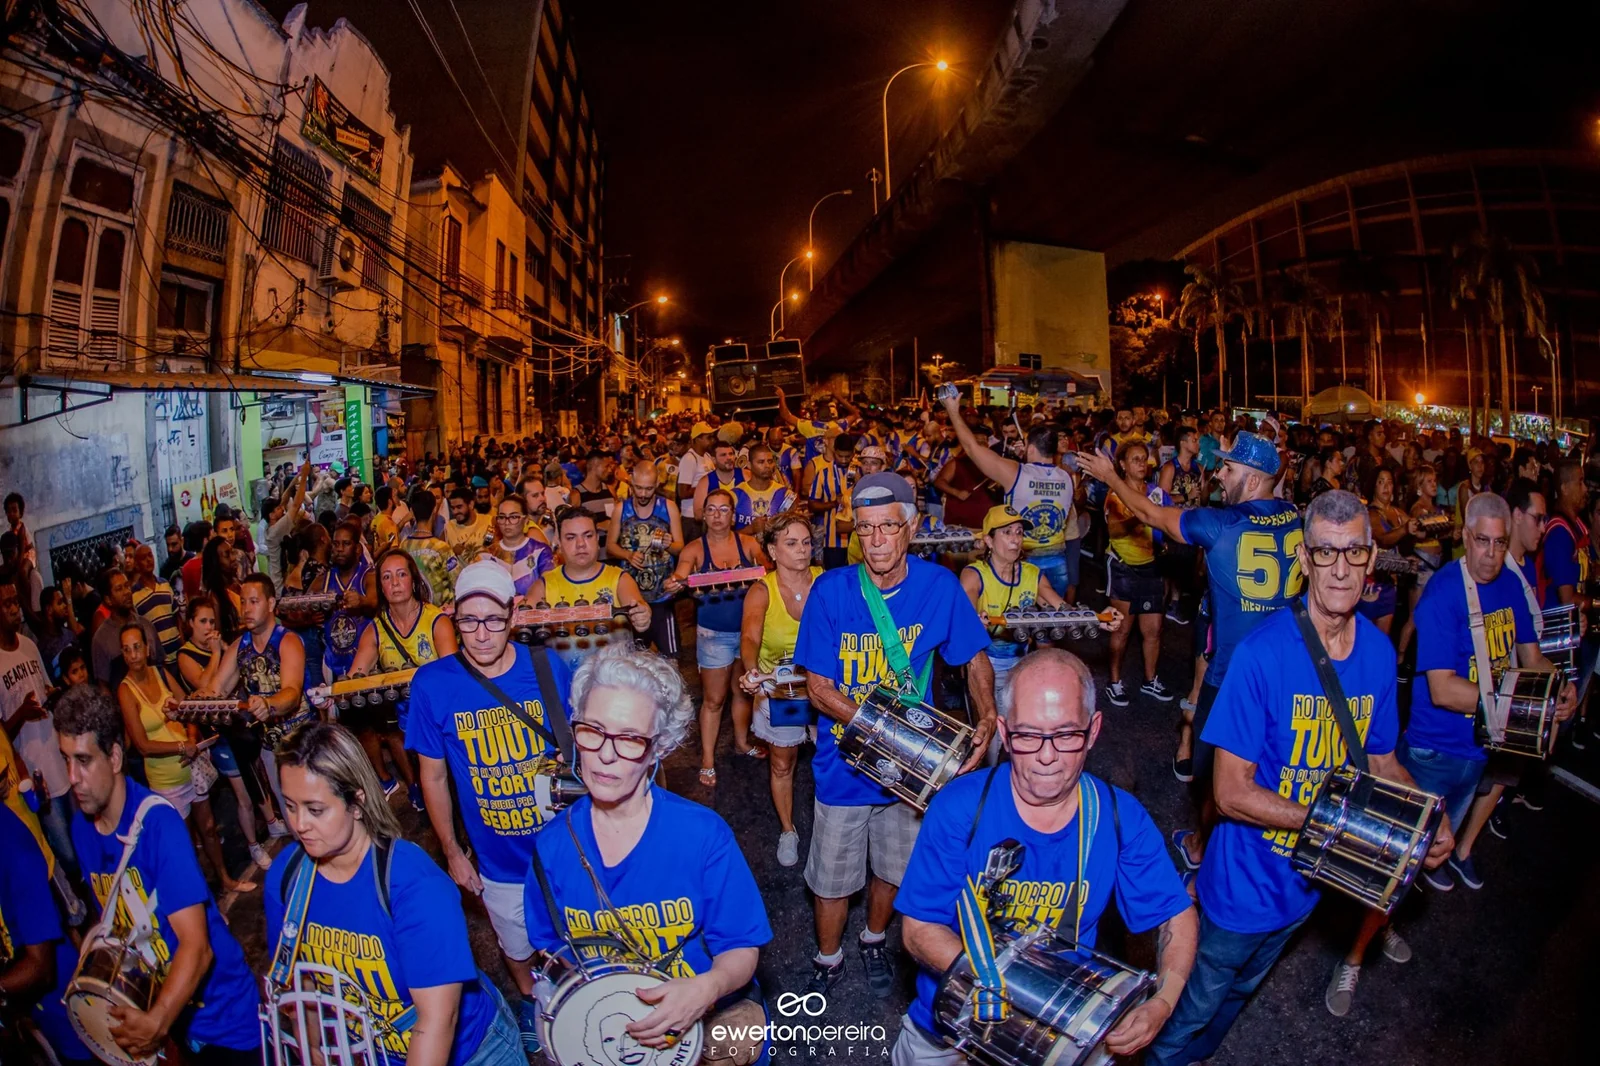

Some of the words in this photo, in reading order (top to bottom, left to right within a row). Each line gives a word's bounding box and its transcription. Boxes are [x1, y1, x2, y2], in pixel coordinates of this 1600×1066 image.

[1029, 480, 1066, 490] DIRETOR
[1033, 489, 1061, 497] BATERIA
[1236, 528, 1305, 600] 52
[841, 632, 858, 652] NO
[2, 661, 29, 690] BEACH
[454, 711, 475, 731] NO
[476, 704, 522, 728] MORR
[524, 699, 544, 718] DO
[1292, 694, 1314, 719] NO
[472, 776, 484, 795] O
[488, 771, 537, 797] CORT
[480, 766, 501, 779] ALTO
[502, 765, 515, 776] DO
[1280, 766, 1296, 781] NO
[490, 799, 516, 810] SUBIR
[517, 795, 535, 807] PRA
[480, 806, 543, 830] SEBAST
[564, 906, 593, 931] NO
[660, 897, 694, 926] DO
[306, 922, 358, 958] MORRO
[358, 933, 385, 960] DO
